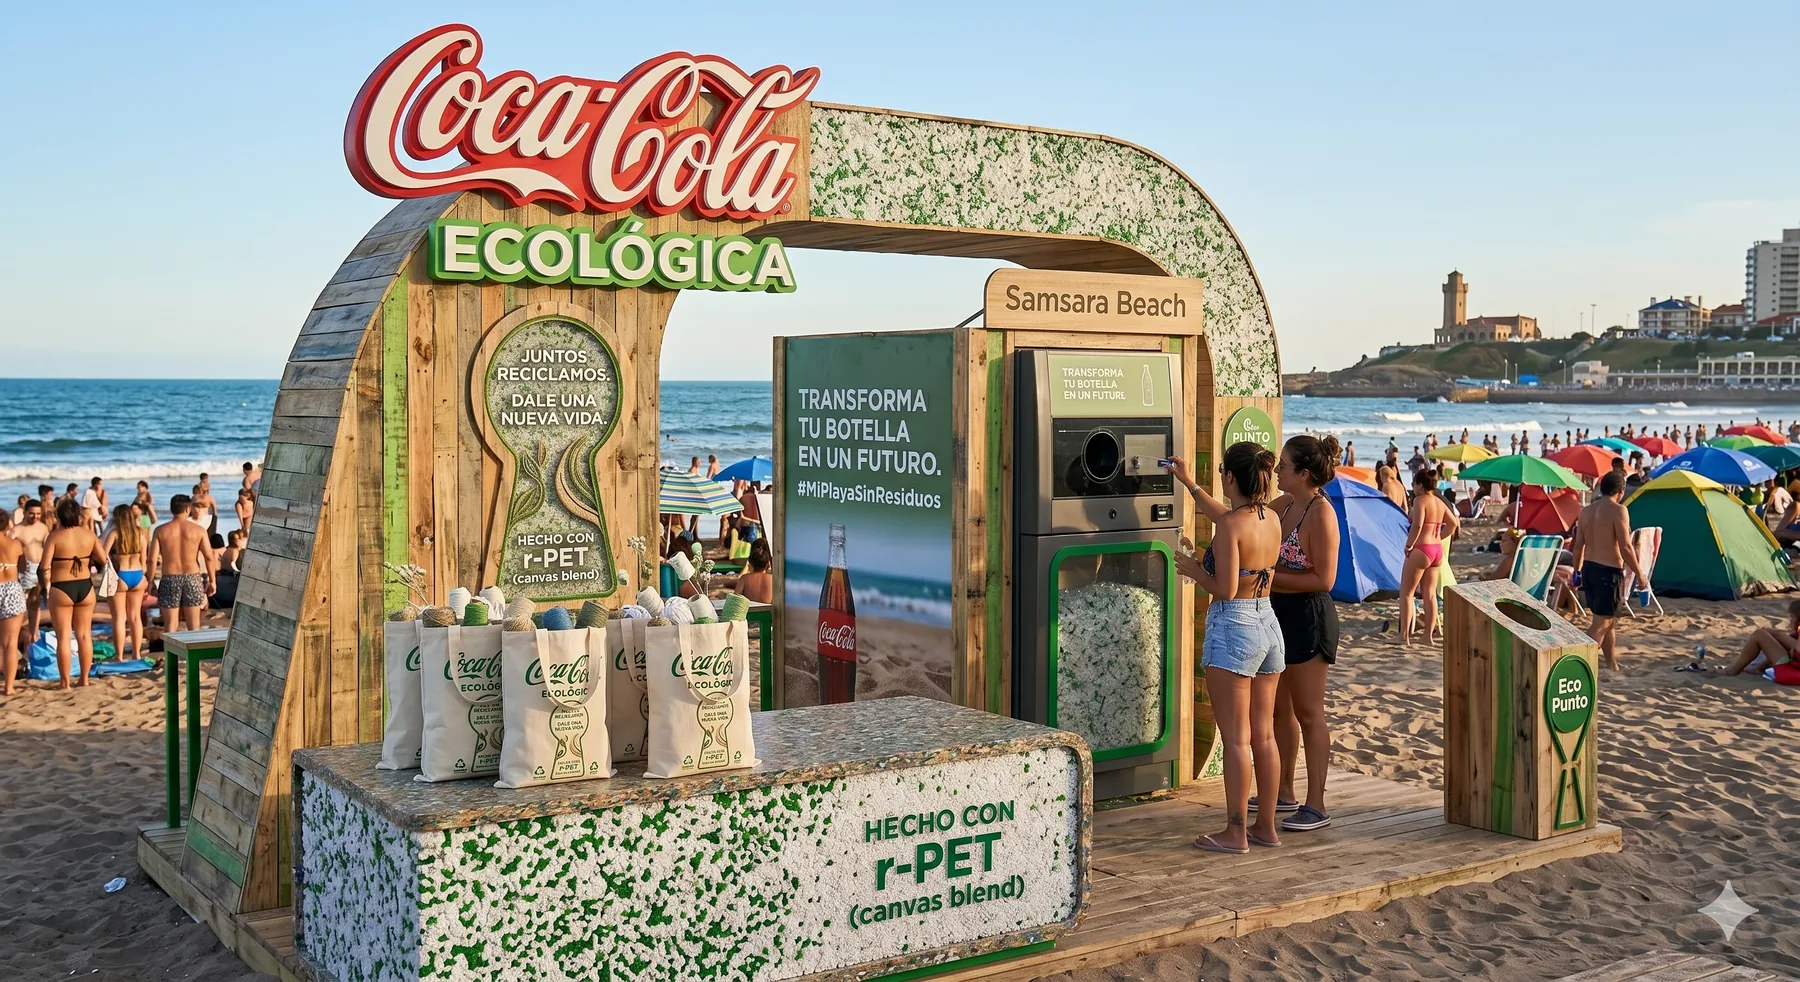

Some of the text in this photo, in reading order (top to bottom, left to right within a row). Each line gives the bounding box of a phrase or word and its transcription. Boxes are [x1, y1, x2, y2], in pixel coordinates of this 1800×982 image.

[364, 30, 818, 212] Coca-Cola
[443, 220, 793, 288] ECOLÓGICA
[1005, 284, 1186, 318] Samsara Beach
[521, 349, 588, 364] JUNTOS
[497, 367, 611, 382] RECICLAMOS.
[1062, 367, 1124, 378] TRANSFORMA
[1063, 379, 1118, 389] TU BOTELLA
[512, 393, 597, 408] DALE UNA
[798, 388, 927, 412] TRANSFORMA
[1064, 390, 1076, 400] EN
[1078, 390, 1091, 400] UN
[501, 411, 608, 426] NUEVA VIDA.
[798, 417, 911, 443] TU BOTELLA
[1232, 431, 1271, 443] PUNTO
[798, 445, 942, 476] EN UN FUTURO.
[797, 480, 942, 509] #MiPlayaSinResiduos
[517, 532, 595, 546] HECHO CON
[523, 546, 589, 569] r-PET
[512, 570, 600, 585] (canvas blend)
[818, 620, 856, 651] Coca-Cola
[1558, 677, 1582, 695] Eco
[1552, 694, 1588, 714] Punto
[865, 799, 1015, 843] HECHO CON
[876, 831, 1002, 891] r-PET
[849, 874, 1025, 930] (canvas blend)
